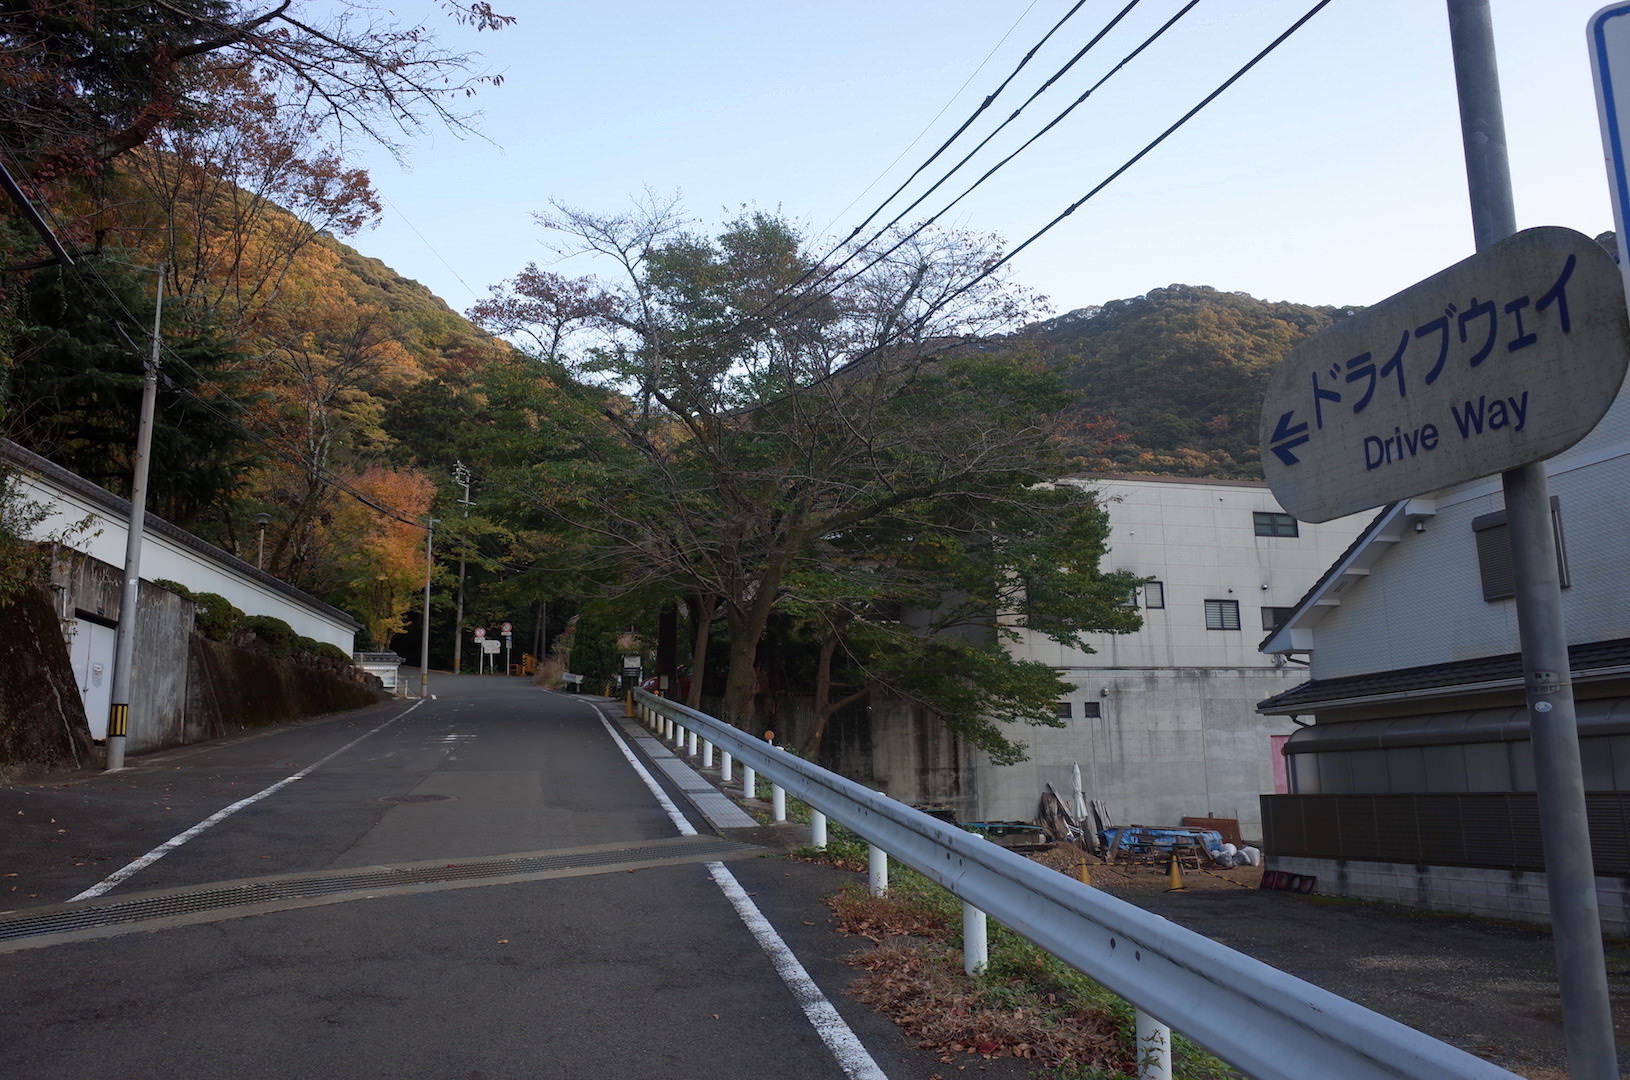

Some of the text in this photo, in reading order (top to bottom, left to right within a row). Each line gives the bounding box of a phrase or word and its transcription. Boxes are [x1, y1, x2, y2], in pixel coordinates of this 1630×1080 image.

[1312, 254, 1576, 429] ドライブウェイ
[1364, 391, 1528, 470] Drive Way
